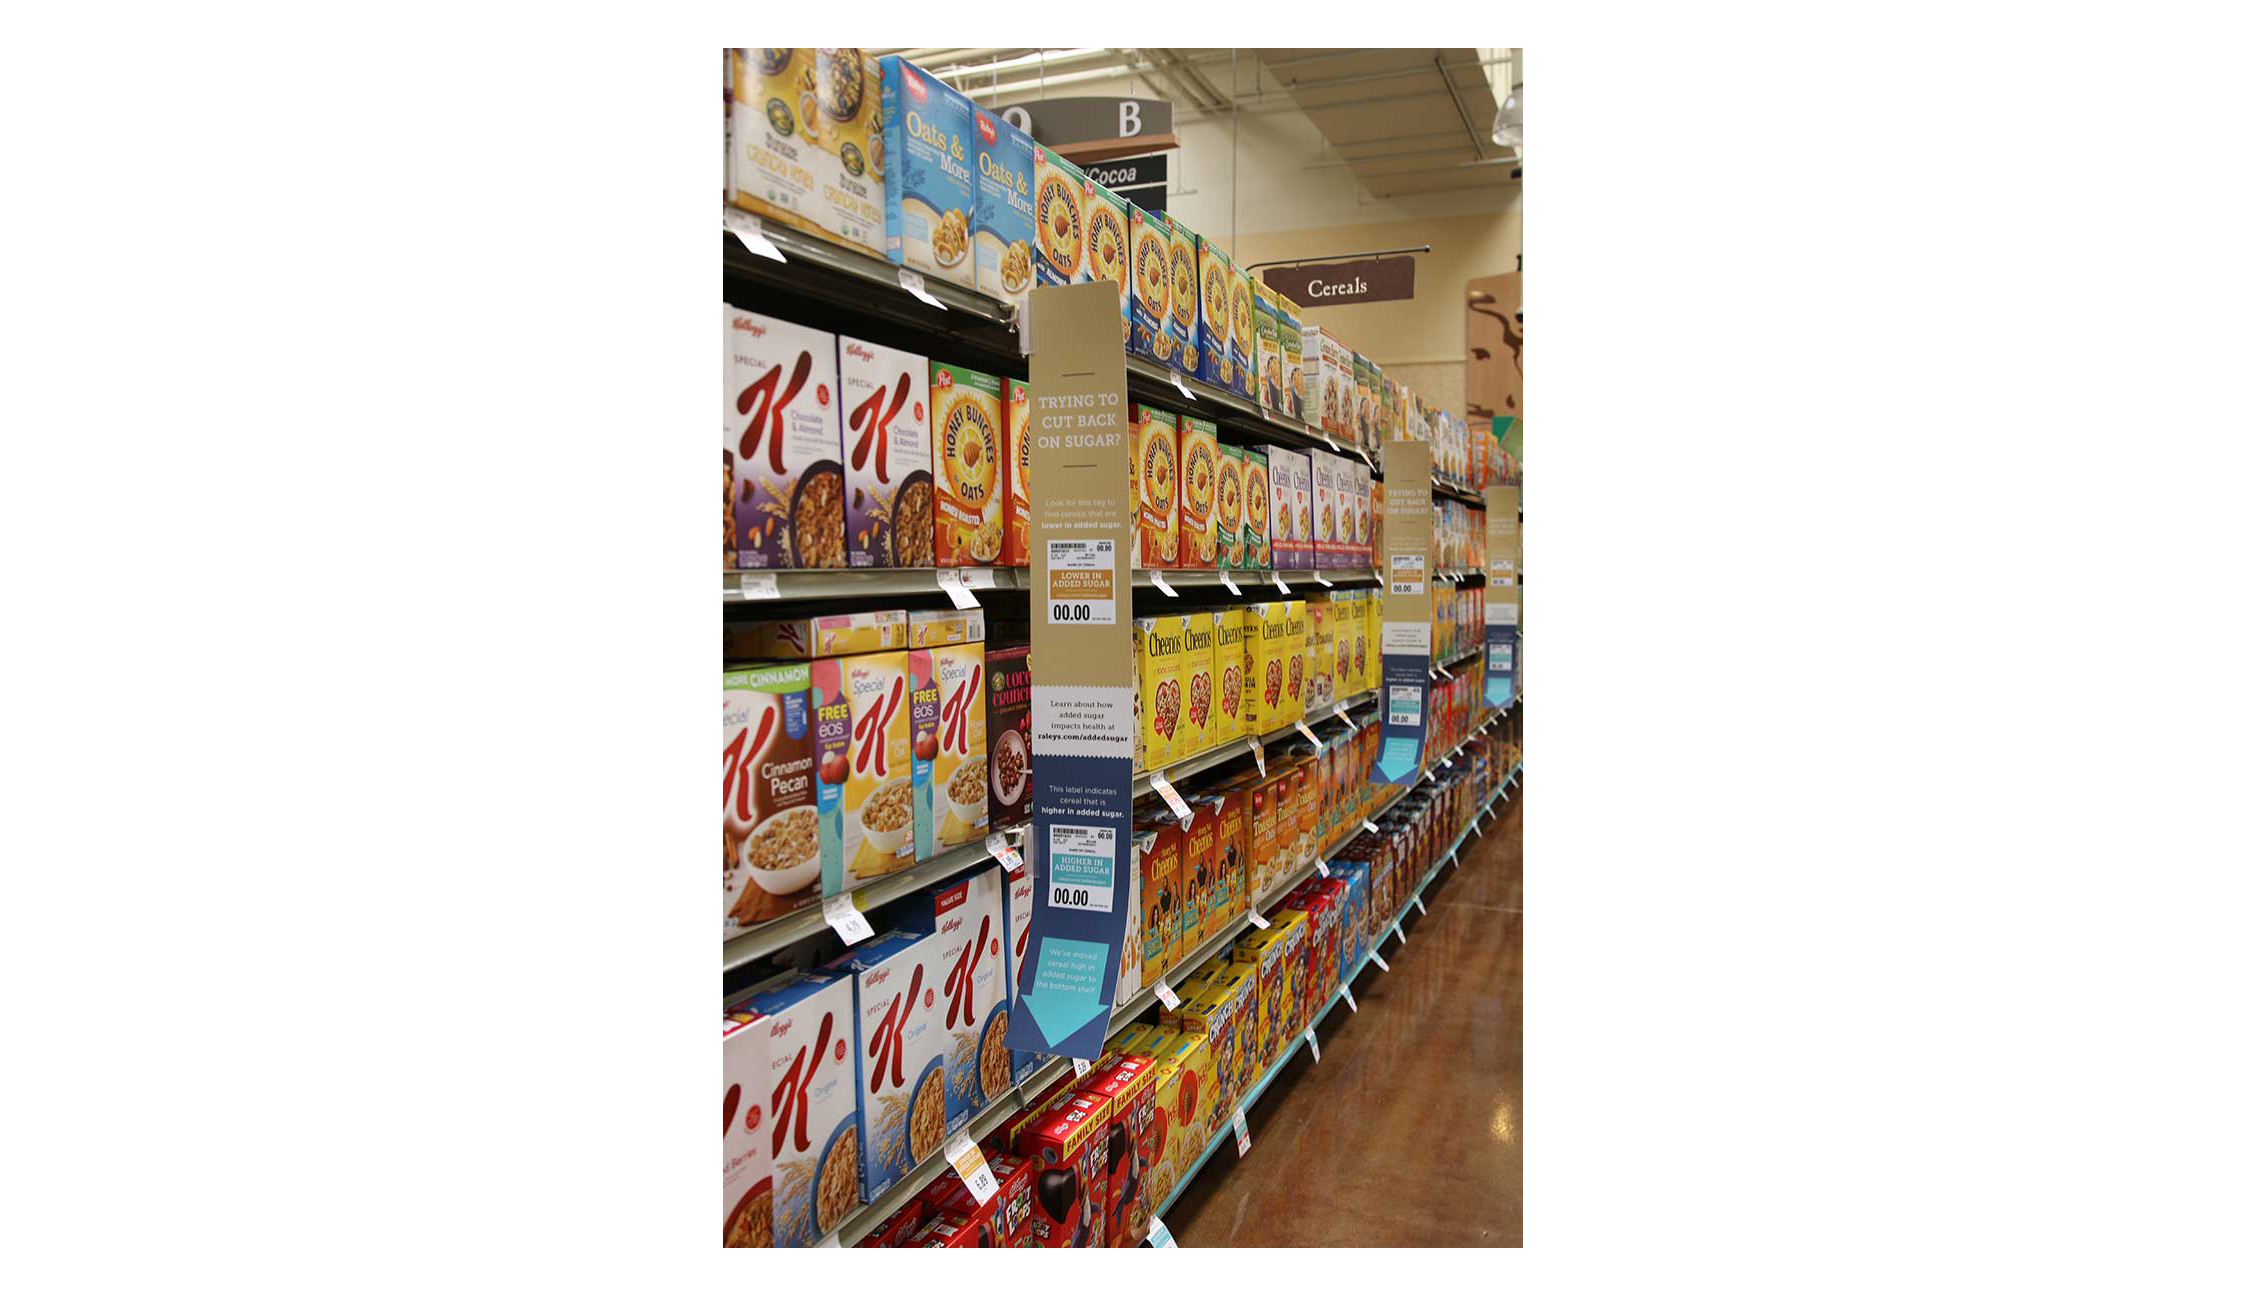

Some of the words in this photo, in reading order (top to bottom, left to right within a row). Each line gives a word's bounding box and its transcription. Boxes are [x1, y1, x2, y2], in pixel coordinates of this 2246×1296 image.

[1119, 101, 1142, 138] B
[907, 111, 947, 152] Oats
[951, 134, 964, 162] &
[940, 151, 971, 184] More
[979, 151, 1013, 188] Oats
[1016, 171, 1028, 196] &
[1007, 189, 1033, 216] More
[1040, 183, 1055, 225] HONEY
[1056, 182, 1080, 241] BUNCHES
[1091, 215, 1103, 253] HONEY
[1105, 213, 1124, 267] BUNCHES
[1052, 248, 1072, 268] OATS
[1308, 277, 1368, 298] Cereals
[733, 354, 768, 370] SPECIAL
[847, 376, 875, 390] SPECIAL
[1038, 393, 1095, 409] TRYING
[1098, 393, 1119, 406] TO
[737, 350, 812, 476] K
[1042, 415, 1074, 429] CUT
[1078, 413, 1116, 427] BACK
[849, 372, 911, 485] K
[947, 412, 964, 458] HONEY
[966, 404, 994, 465] BUNCHES
[1038, 436, 1060, 449] ON
[1065, 434, 1121, 448] SUGAR?
[960, 482, 985, 502] OATS
[1074, 521, 1098, 529] added
[1052, 580, 1082, 588] ADDED
[1083, 580, 1110, 588] SUGAR
[1061, 571, 1091, 580] LOWER
[1092, 571, 1102, 580] IN
[1393, 585, 1412, 593] 00.00
[1053, 604, 1091, 621] 00.00
[1184, 628, 1212, 652] Cheerios
[1217, 624, 1243, 647] Cheerios
[1149, 632, 1182, 658] Cheerios
[750, 668, 809, 688] CINNAMON
[941, 664, 967, 681] Special
[853, 679, 886, 695] Special
[913, 689, 938, 704] FREE
[1051, 700, 1072, 708] Learn
[1096, 701, 1114, 709] how
[818, 704, 848, 722] FREE
[914, 705, 934, 719] eos
[942, 664, 980, 755] K
[819, 722, 844, 738] eos
[854, 675, 904, 777] K
[1051, 722, 1080, 731] impacts
[1038, 733, 1128, 743] raleys.com/addedsugar
[761, 757, 813, 780] Cinnamon
[771, 775, 809, 797] Pecan
[1049, 785, 1064, 793] This
[1065, 786, 1084, 794] label
[1085, 786, 1118, 796] indicates
[1060, 797, 1082, 805] cereal
[1083, 798, 1098, 806] that
[1041, 806, 1066, 815] higher
[1076, 808, 1100, 817] added
[1101, 810, 1125, 819] sugar.
[1054, 864, 1082, 873] ADDED
[1083, 865, 1110, 875] SUGAR
[1061, 856, 1092, 866] HIGHER
[1094, 859, 1104, 867] IN
[1054, 888, 1089, 907] 00.00
[942, 945, 962, 960] SPECIAL
[1050, 947, 1071, 957] We've
[1073, 952, 1098, 961] moved
[944, 914, 990, 1031] K
[1042, 970, 1066, 979] added
[1089, 975, 1097, 983] to
[1049, 982, 1076, 992] bottom
[866, 1000, 891, 1017] SPECIAL
[869, 963, 923, 1094] K
[1116, 1085, 1141, 1109] FAMILY
[1142, 1066, 1156, 1084] SIZE
[1067, 1120, 1094, 1153] FAMILY
[1095, 1105, 1110, 1122] SIZE
